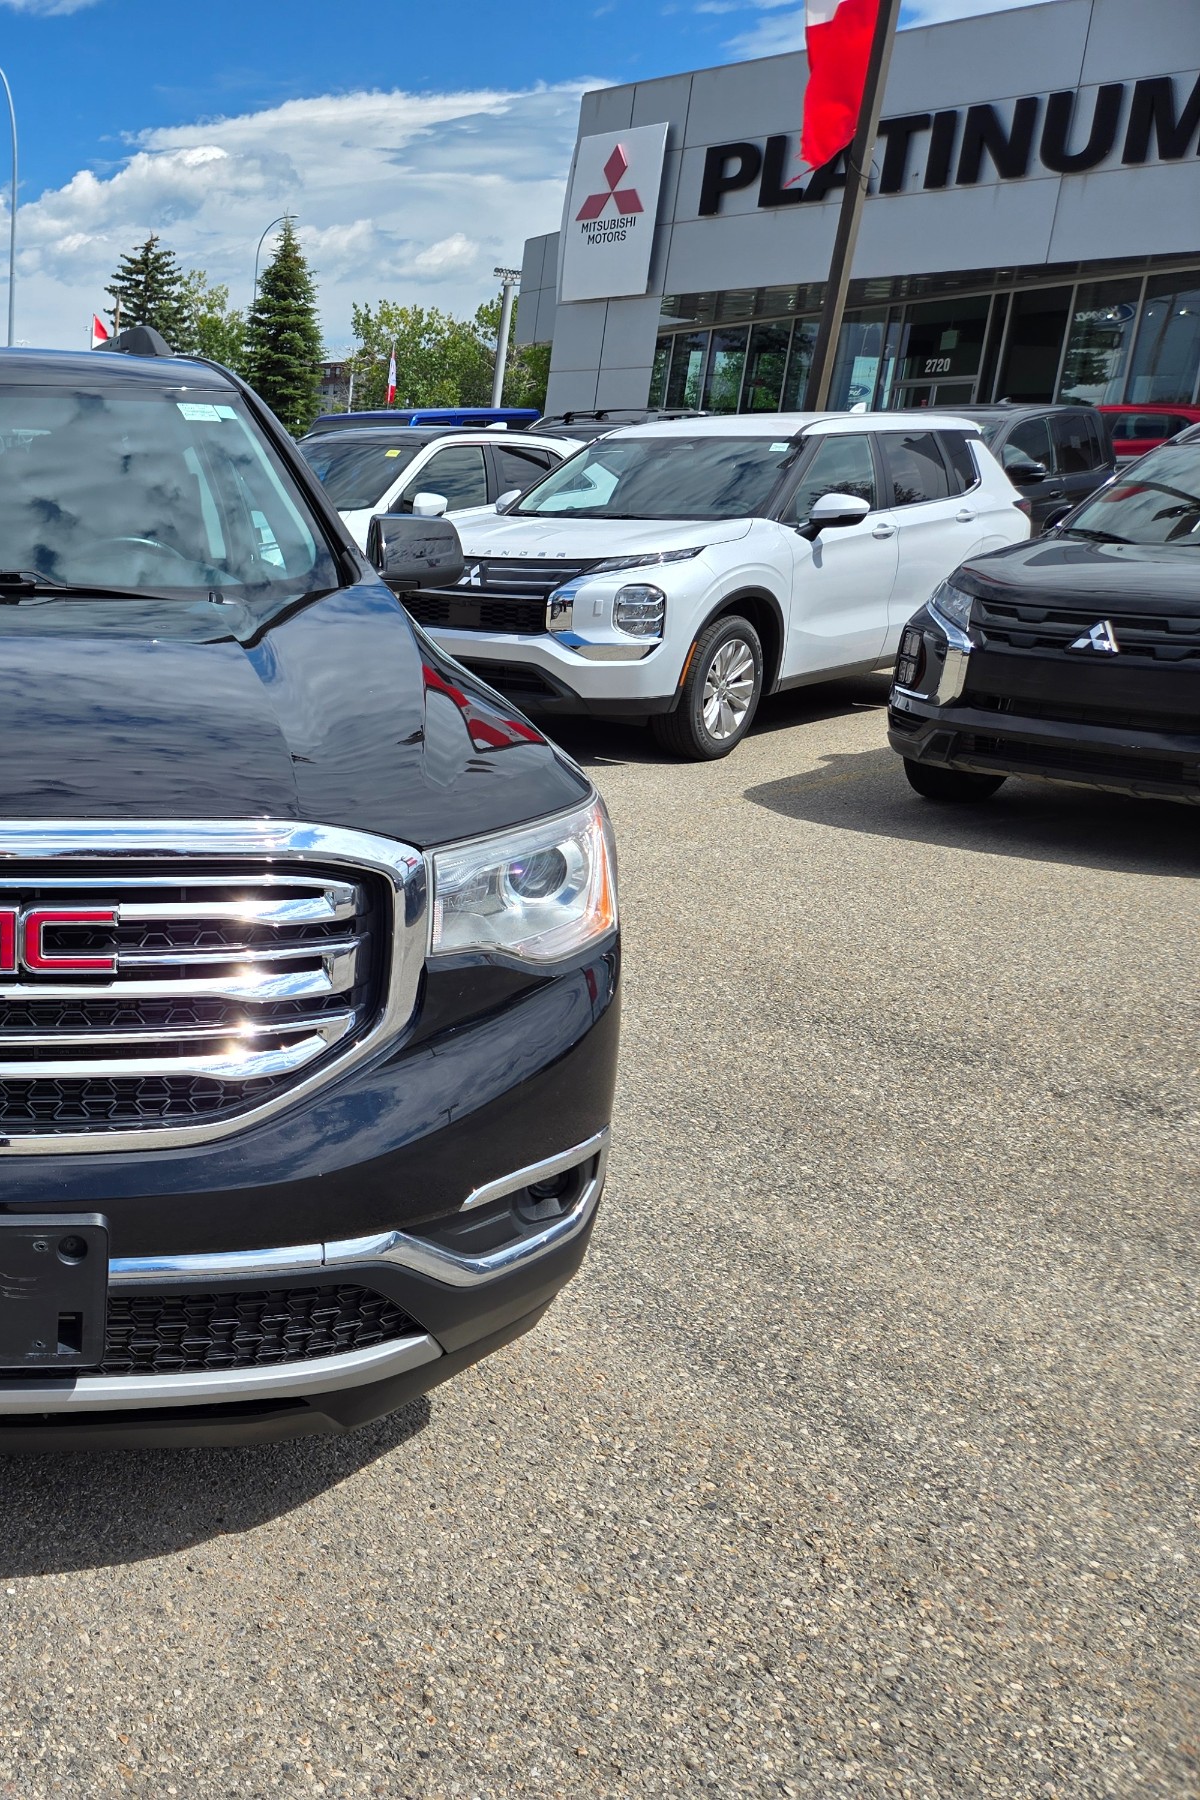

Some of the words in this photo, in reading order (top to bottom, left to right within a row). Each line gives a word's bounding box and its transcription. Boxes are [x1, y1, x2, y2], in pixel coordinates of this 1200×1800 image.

[581, 216, 637, 233] MITSUBISHI
[587, 230, 627, 245] MOTORS
[924, 357, 951, 373] 2720
[469, 548, 566, 558] LANDER
